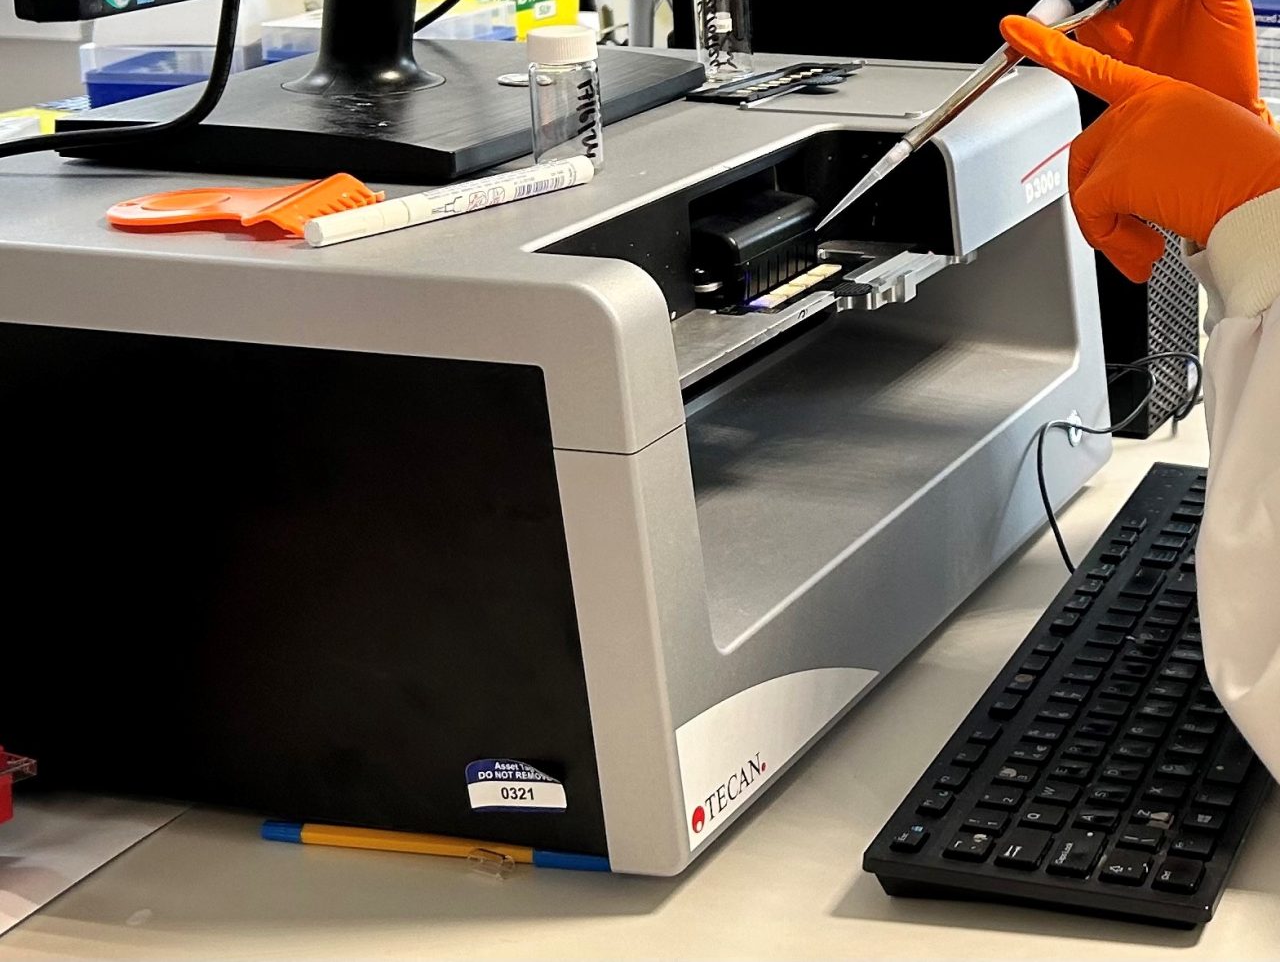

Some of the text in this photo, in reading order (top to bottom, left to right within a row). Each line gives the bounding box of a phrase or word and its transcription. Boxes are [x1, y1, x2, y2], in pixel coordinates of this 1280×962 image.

[1025, 169, 1061, 206] D300e
[494, 761, 519, 771] Asset
[477, 771, 494, 781] DO
[494, 771, 514, 780] NOT
[500, 787, 535, 801] 0321
